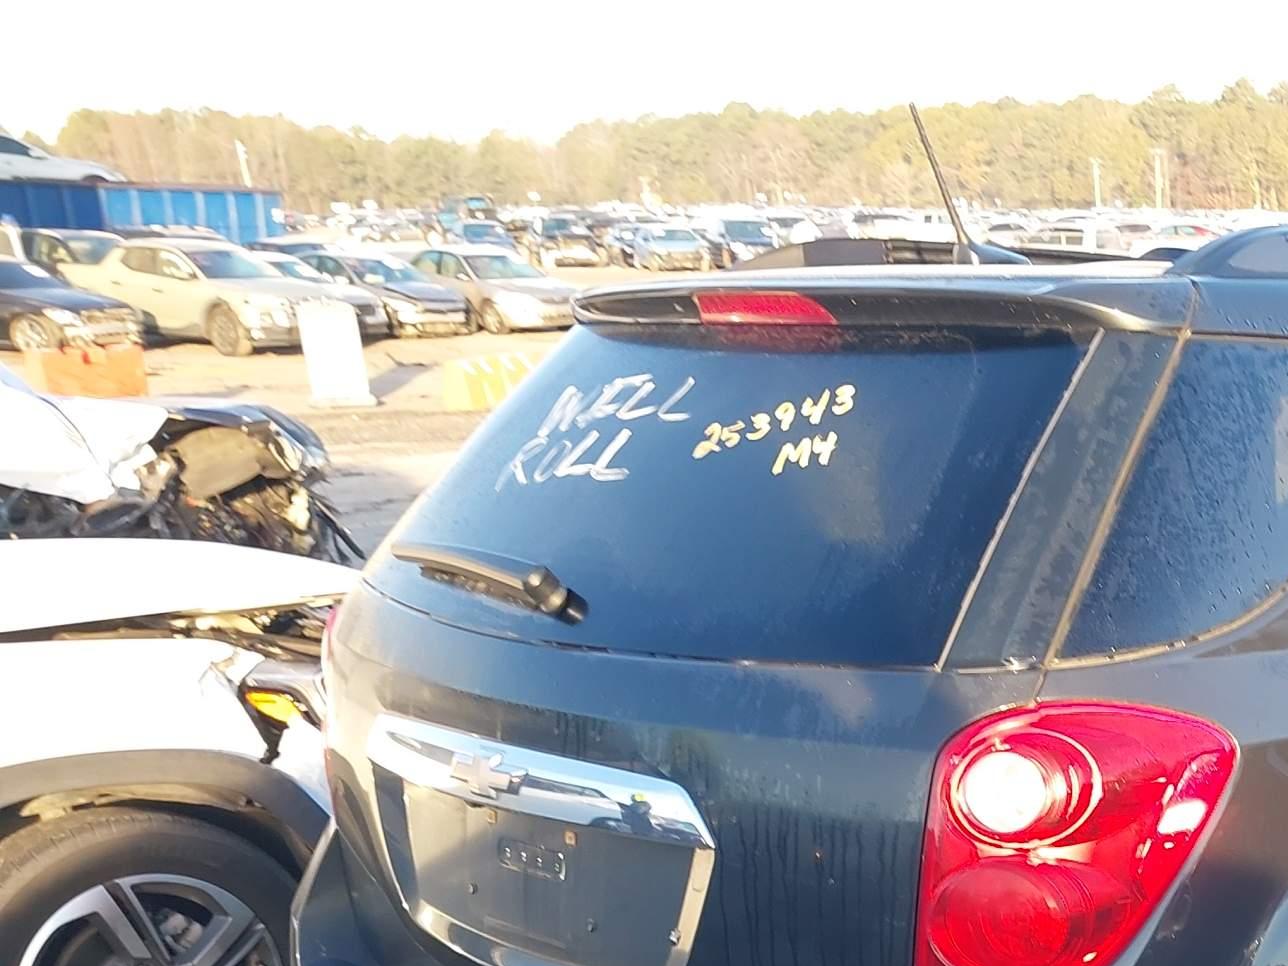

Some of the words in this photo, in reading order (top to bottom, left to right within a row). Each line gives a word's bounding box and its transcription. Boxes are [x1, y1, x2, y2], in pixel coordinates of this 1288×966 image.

[692, 384, 856, 460] 253943
[771, 431, 838, 476] M4
[494, 428, 632, 492] ROLL
